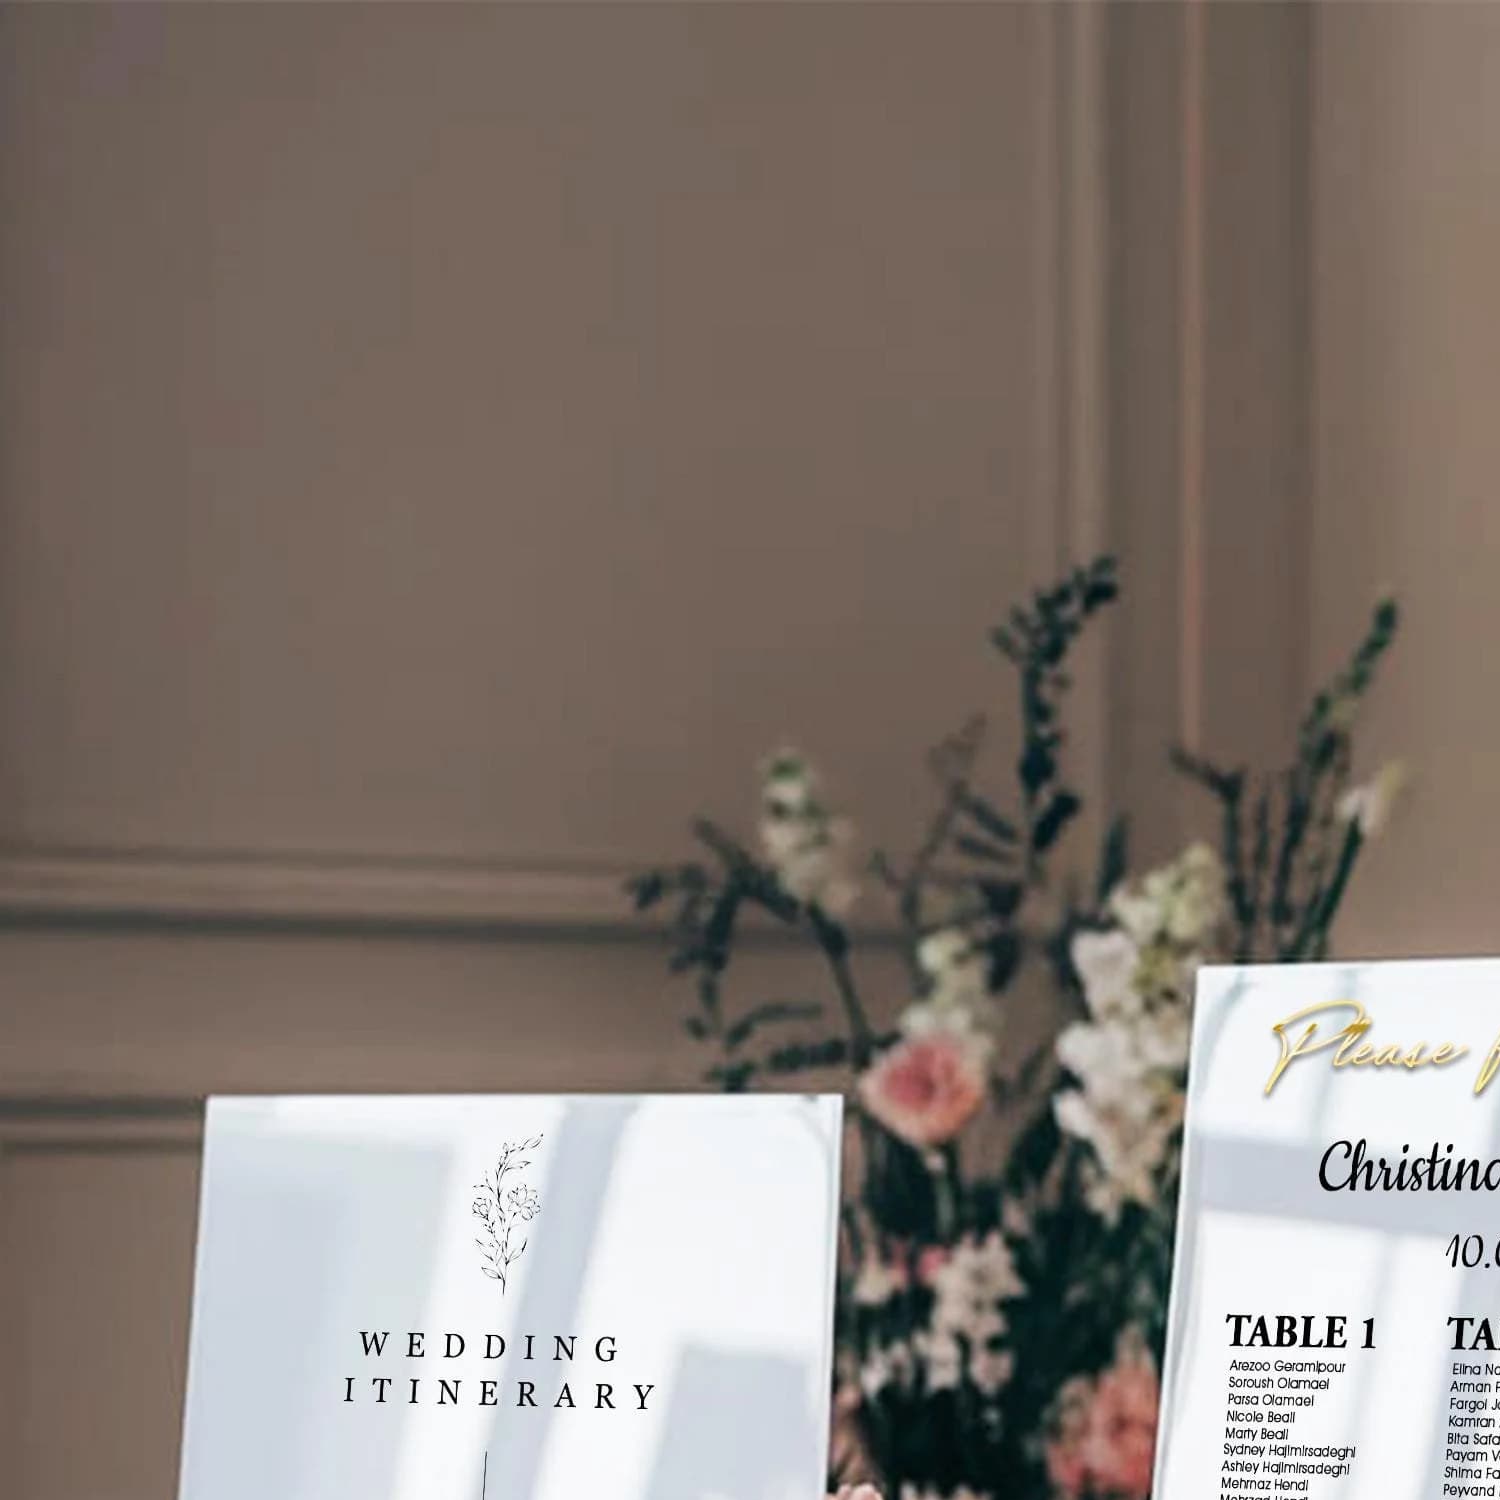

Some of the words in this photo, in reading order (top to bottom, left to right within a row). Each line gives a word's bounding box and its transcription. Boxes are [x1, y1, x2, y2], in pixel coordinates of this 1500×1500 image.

[1263, 1000, 1466, 1096] Please
[1225, 1313, 1348, 1349] TABLE
[1360, 1317, 1377, 1349] 1
[358, 1331, 618, 1363] WEDDING
[343, 1377, 655, 1410] ITINERARY
[1227, 1392, 1260, 1406] Parsa
[1449, 1397, 1488, 1414] Fargol
[1225, 1426, 1258, 1442] Marty
[1443, 1483, 1496, 1499] Peyvand
